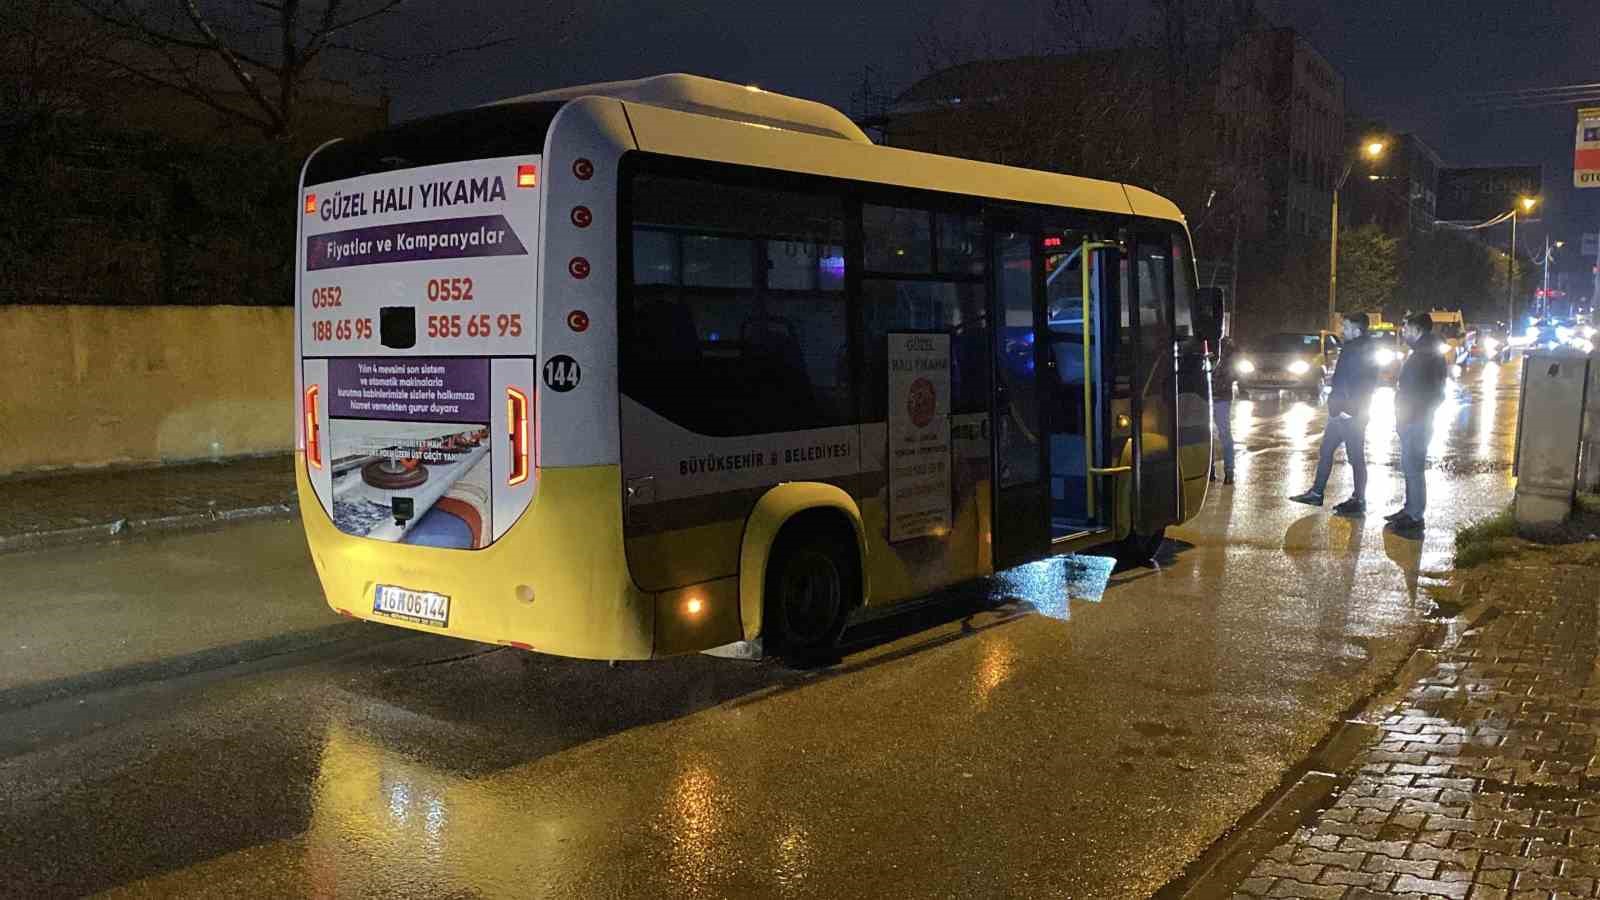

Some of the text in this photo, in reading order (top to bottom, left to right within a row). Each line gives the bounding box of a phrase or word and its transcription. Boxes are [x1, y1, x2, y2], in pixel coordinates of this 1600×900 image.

[321, 176, 506, 222] GÜZEL HALI YIKAMA
[327, 227, 505, 260] Fiyatlar ve Kampanyalar
[312, 286, 342, 308] 0552
[428, 278, 473, 301] 0552
[312, 318, 373, 342] 188 65 95
[428, 313, 522, 338] 585 65 95
[378, 364, 405, 374] mevsimi
[407, 366, 420, 374] son
[421, 364, 445, 374] sistem
[545, 361, 578, 386] 144
[360, 378, 368, 386] ve
[399, 377, 443, 387] makinalarla
[410, 389, 435, 400] sizlerle
[437, 389, 475, 400] halkımıza
[351, 400, 459, 415] hizmet vermekten gurur duyarız
